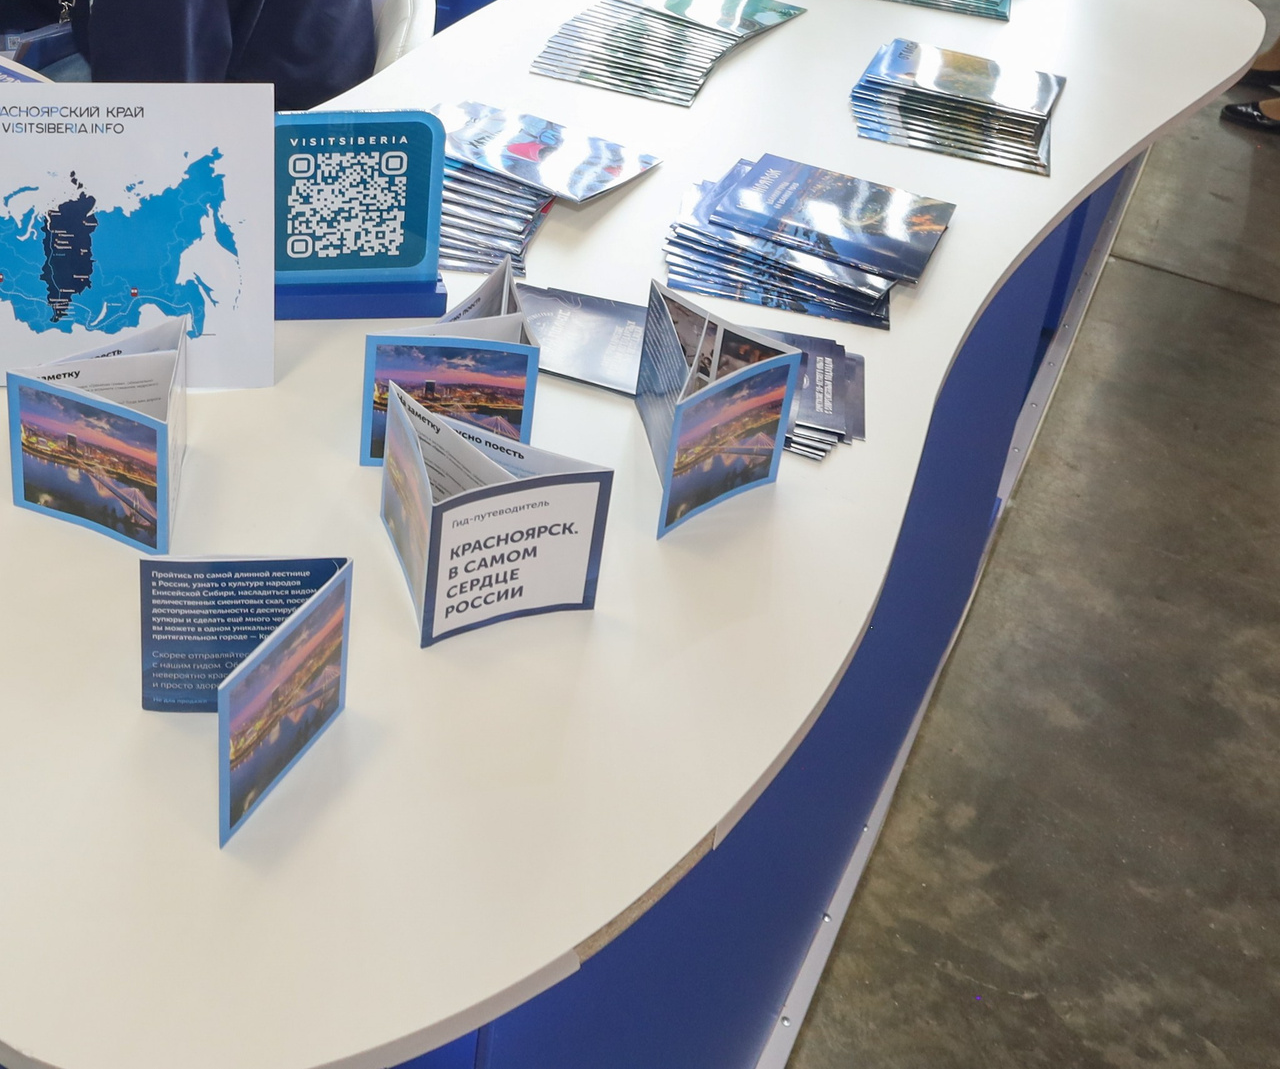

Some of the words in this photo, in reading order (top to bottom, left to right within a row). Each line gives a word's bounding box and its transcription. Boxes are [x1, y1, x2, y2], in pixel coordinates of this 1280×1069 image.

[106, 106, 144, 118] КРАЙ
[2, 122, 124, 134] VISITSIBERIA.INFO
[290, 135, 408, 147] VISITSIBERIA
[37, 370, 80, 381] аметку
[407, 403, 441, 435] заметку
[485, 440, 524, 460] поесть
[452, 500, 550, 529] Гид-путеводитель
[450, 521, 578, 561] КРАСНОЯРСК.
[448, 567, 458, 580] В
[464, 545, 538, 574] САМОМ
[152, 571, 192, 579] Пройтись
[194, 570, 204, 579] по
[206, 570, 232, 579] самой
[234, 570, 270, 578] длинной
[272, 570, 310, 578] лестнице
[266, 579, 301, 587] народов
[446, 568, 520, 599] СЕРДЦЕ
[152, 588, 200, 597] Енисейской
[202, 588, 235, 597] Сибири,
[238, 588, 289, 596] насладиться
[291, 588, 316, 596] видом
[152, 598, 215, 606] величественных
[217, 598, 264, 606] сиенитовых
[266, 598, 284, 606] скал,
[445, 586, 524, 619] РОССИИ
[152, 607, 248, 615] достопримечательности
[153, 633, 218, 641] притягательном
[219, 633, 248, 641] городе
[153, 651, 186, 659] Скорее
[153, 661, 157, 669] с
[160, 661, 191, 669] нашим
[153, 672, 206, 680] невероятно
[153, 682, 158, 690] и
[160, 682, 194, 690] просто
